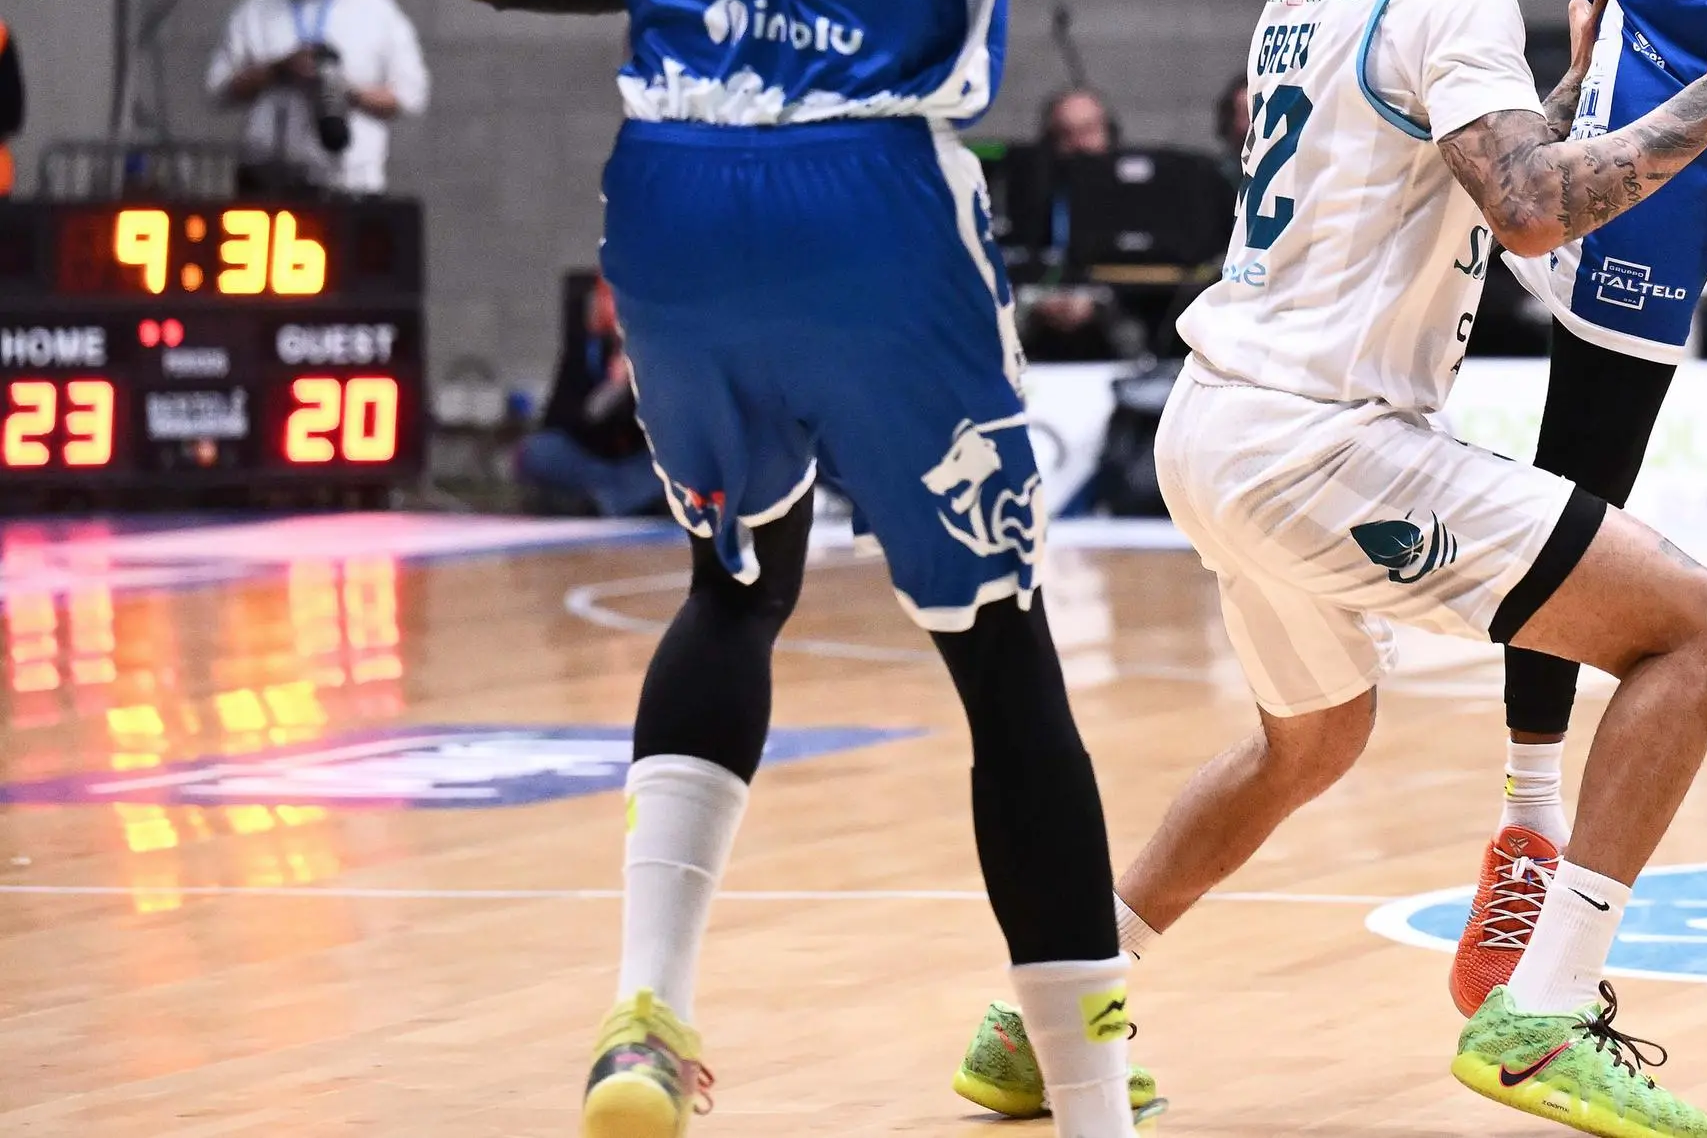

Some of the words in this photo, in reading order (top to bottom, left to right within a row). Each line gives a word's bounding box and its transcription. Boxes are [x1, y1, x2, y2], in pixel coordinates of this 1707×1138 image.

[116, 209, 327, 295] 9:36
[1608, 265, 1645, 278] GRUPPO
[1, 325, 107, 368] HOME
[275, 323, 398, 365] GUEST
[4, 380, 115, 466] 23
[284, 377, 398, 462] 20
